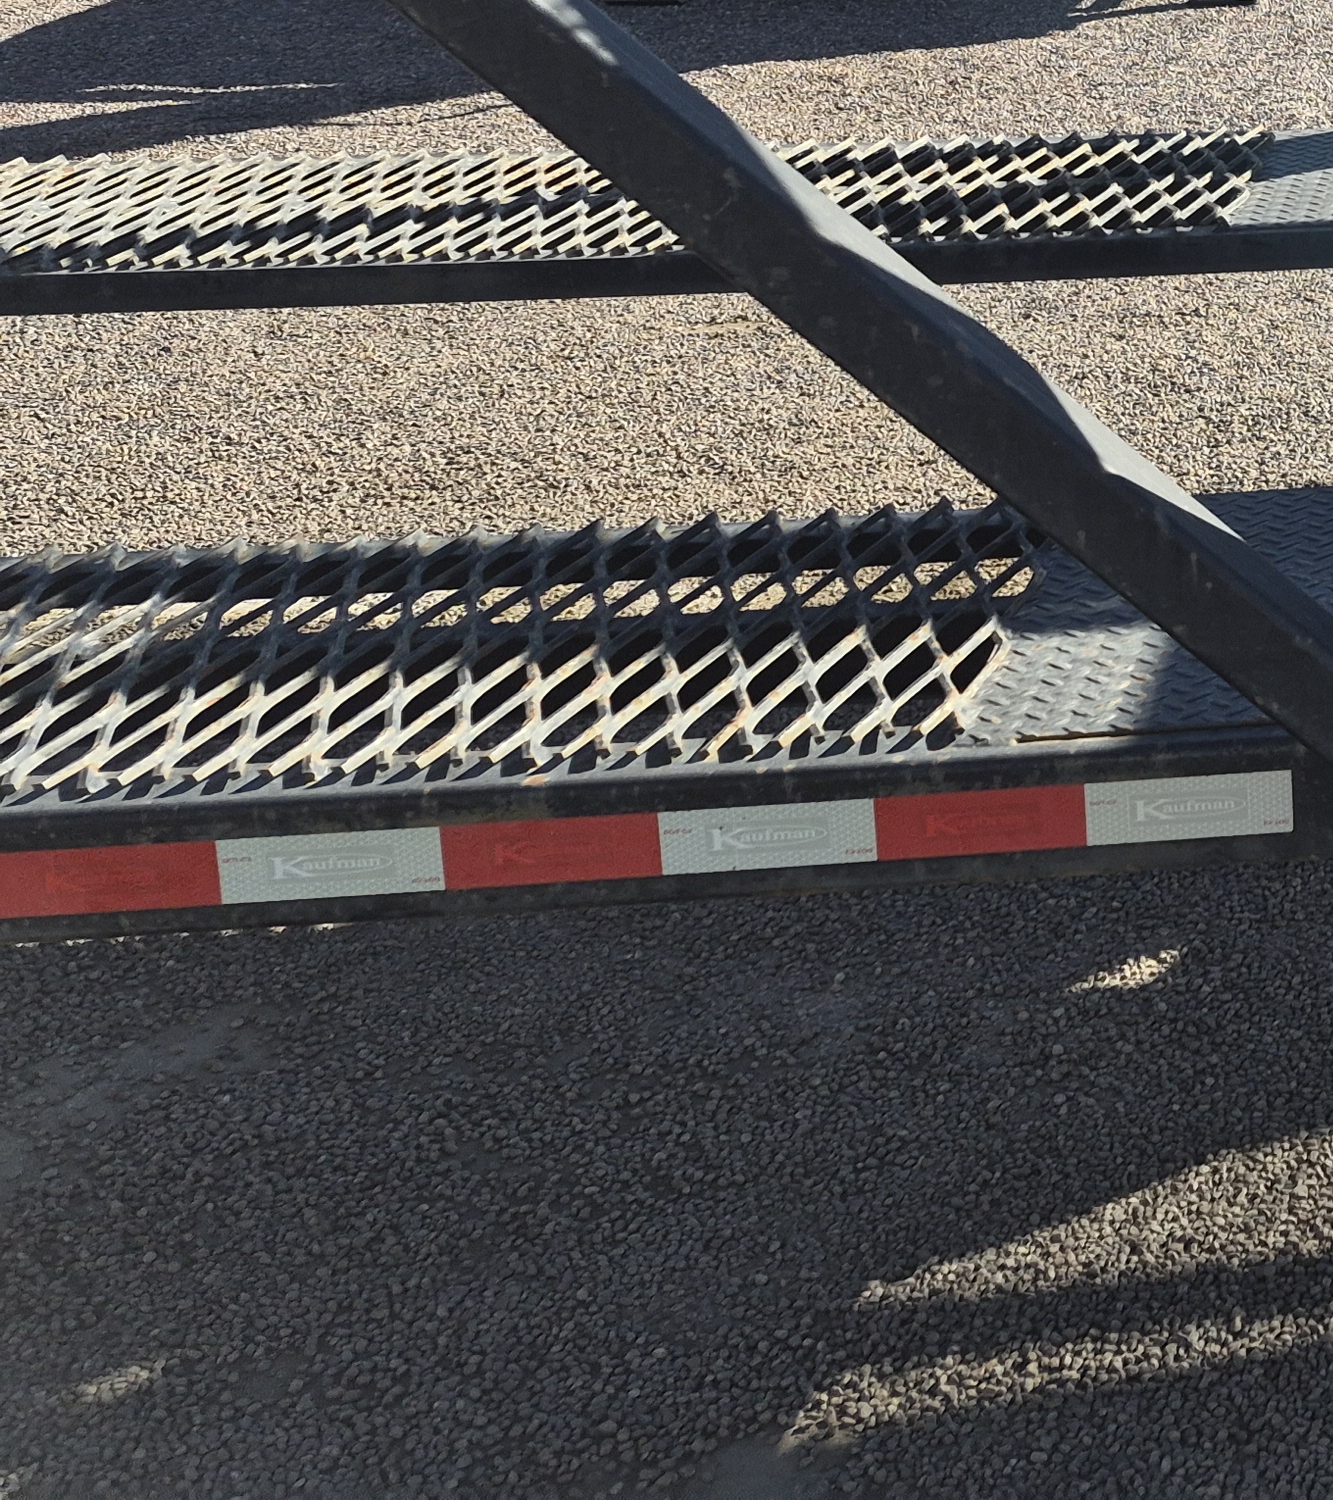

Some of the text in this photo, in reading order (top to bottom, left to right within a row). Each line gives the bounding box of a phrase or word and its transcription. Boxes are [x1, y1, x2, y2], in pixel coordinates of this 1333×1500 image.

[1135, 798, 1236, 822] Kaufman
[710, 827, 818, 851] Kaufman
[270, 855, 383, 881] Kaufman
